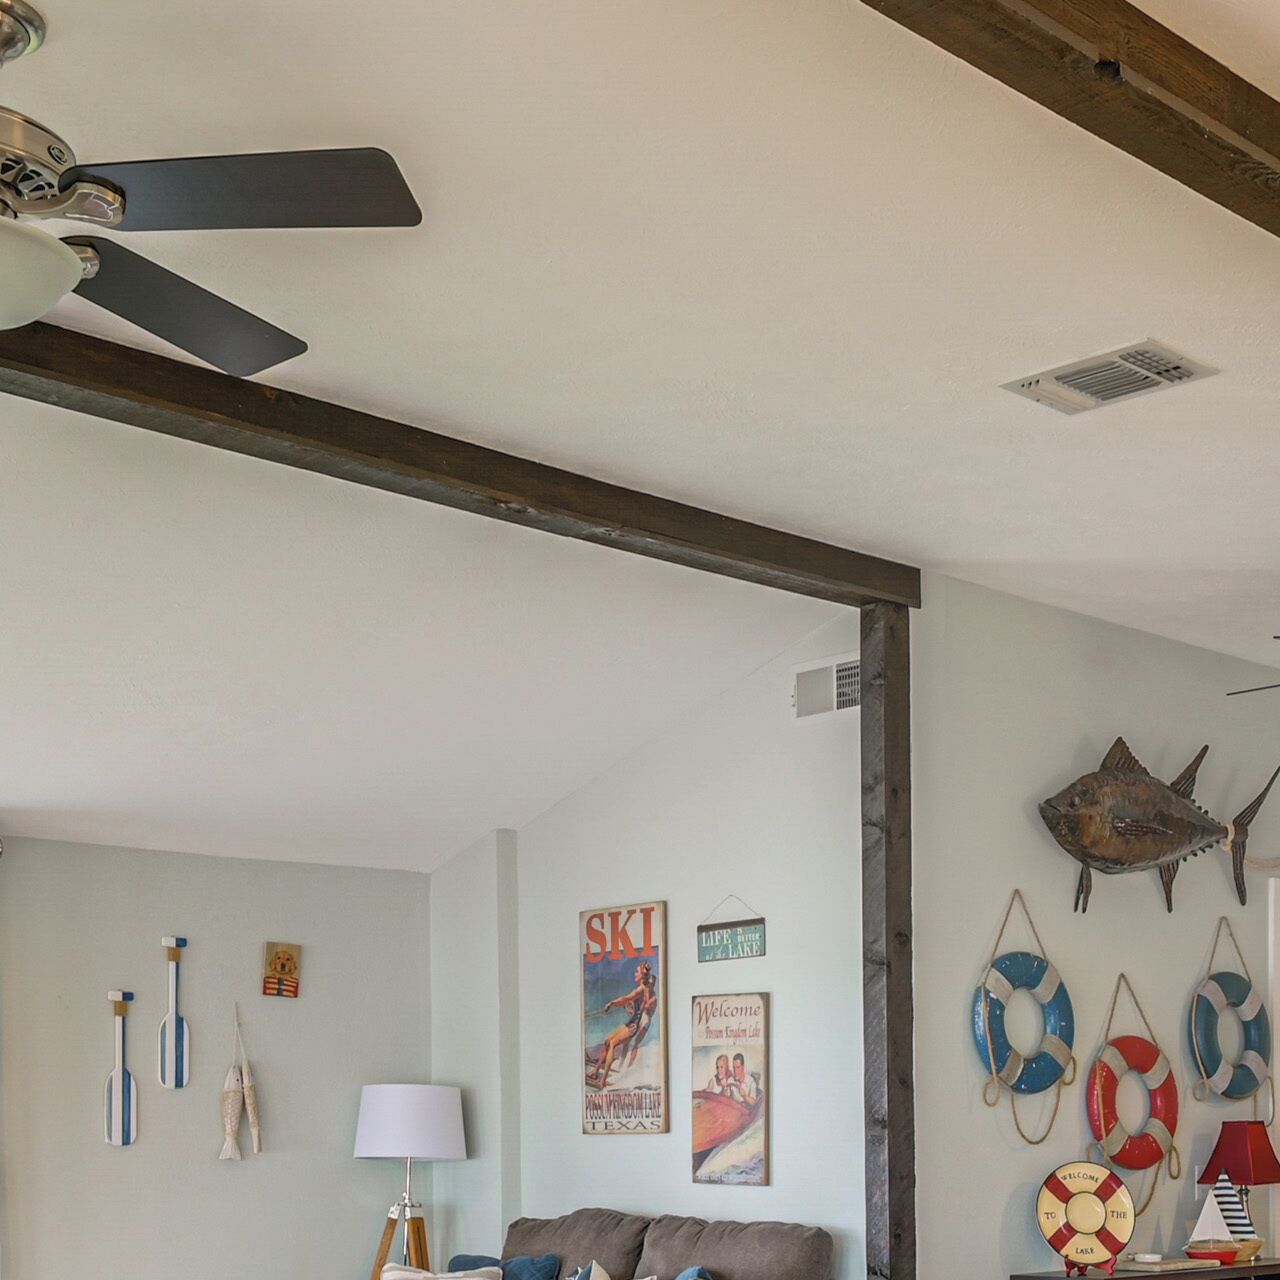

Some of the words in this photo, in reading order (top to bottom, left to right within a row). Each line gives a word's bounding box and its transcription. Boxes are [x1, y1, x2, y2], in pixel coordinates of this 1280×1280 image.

[586, 907, 657, 963] SKI
[702, 929, 732, 947] LIFE
[729, 941, 760, 958] LAKE
[695, 1000, 761, 1025] Welcome
[586, 1120, 661, 1130] TEXAS
[1061, 1172, 1099, 1183] WELCOME
[1044, 1212, 1056, 1220] TO
[1110, 1210, 1128, 1219] THE
